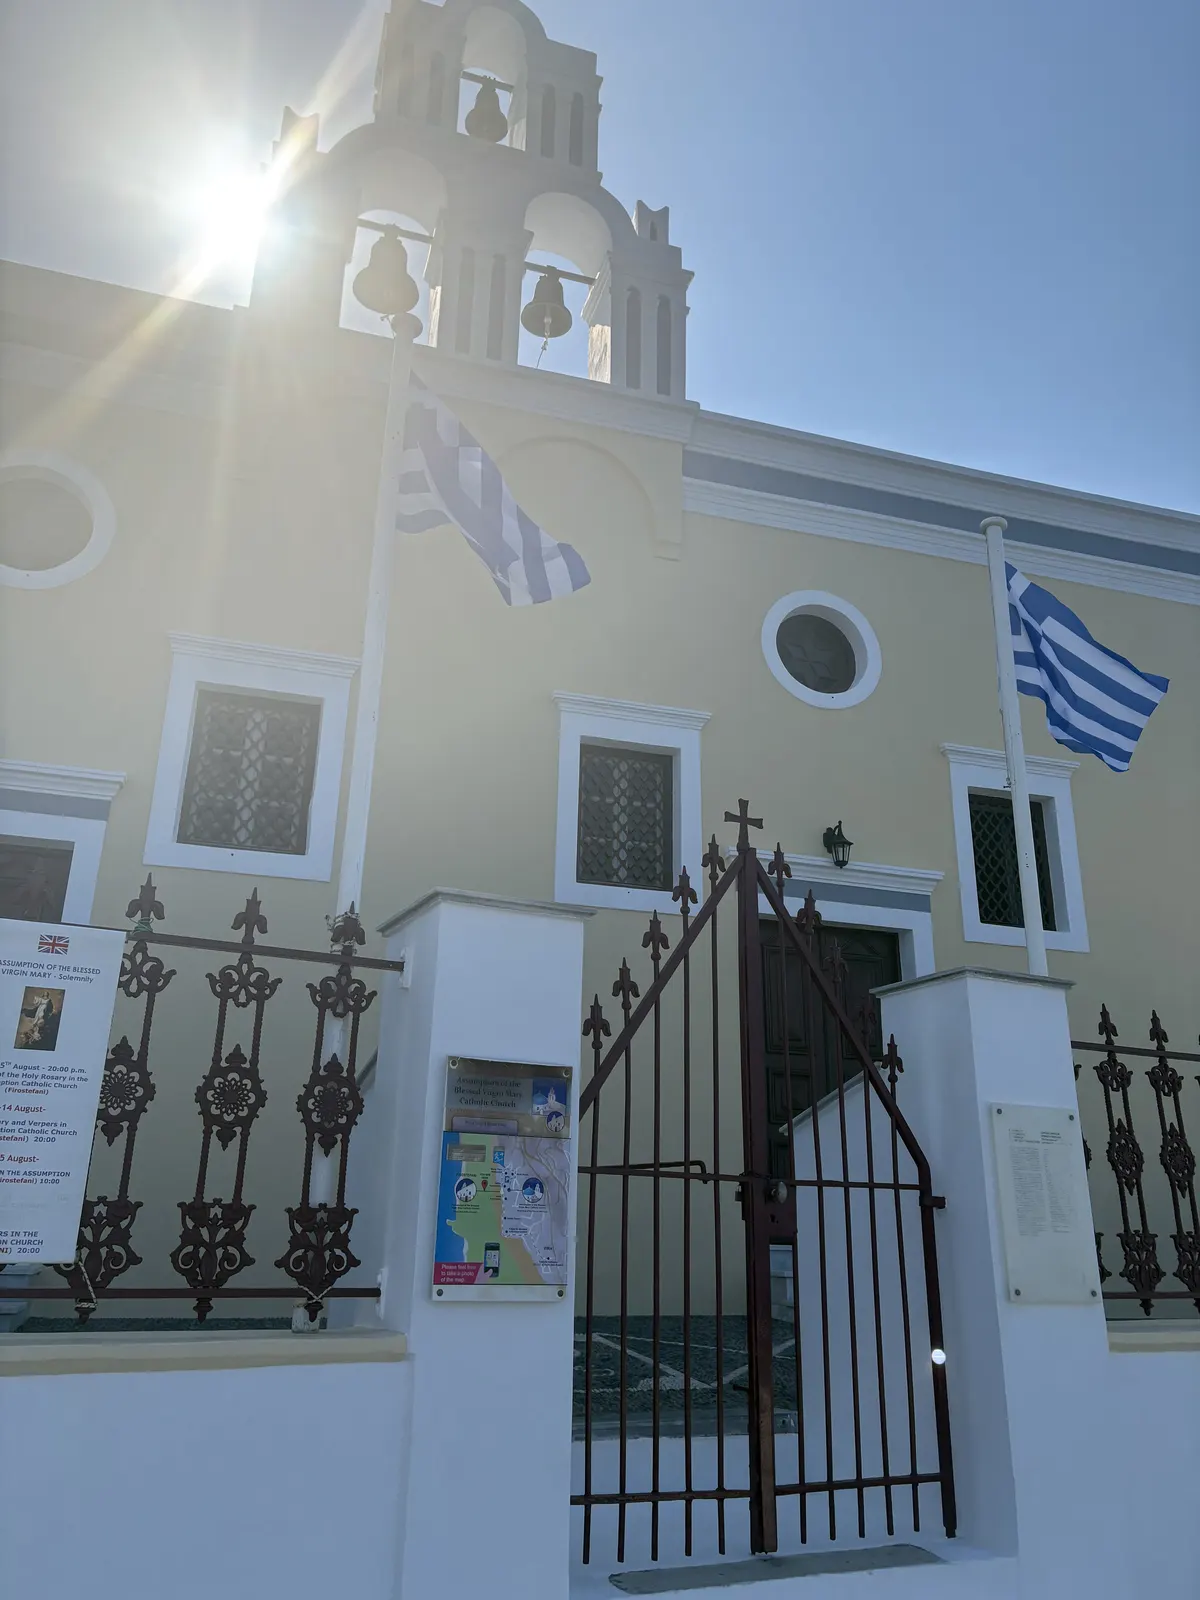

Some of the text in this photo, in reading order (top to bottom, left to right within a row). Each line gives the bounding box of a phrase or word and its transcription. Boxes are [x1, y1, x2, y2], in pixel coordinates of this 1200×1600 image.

[46, 963, 57, 971] OF
[72, 967, 101, 975] BLESSED
[1, 968, 28, 977] VIRGIN
[29, 970, 52, 979] MARY
[58, 973, 94, 984] Solemnity
[12, 1063, 40, 1071] August
[21, 1072, 39, 1080] Holy
[41, 1073, 67, 1081] Rosary
[21, 1080, 52, 1088] Catholic
[4, 1087, 49, 1096] (Firostefani)
[459, 1097, 516, 1108] Catholic Church
[28, 1120, 58, 1128] Verpers
[17, 1127, 49, 1135] Catholic
[50, 1128, 78, 1136] Church
[23, 1230, 39, 1238] THE
